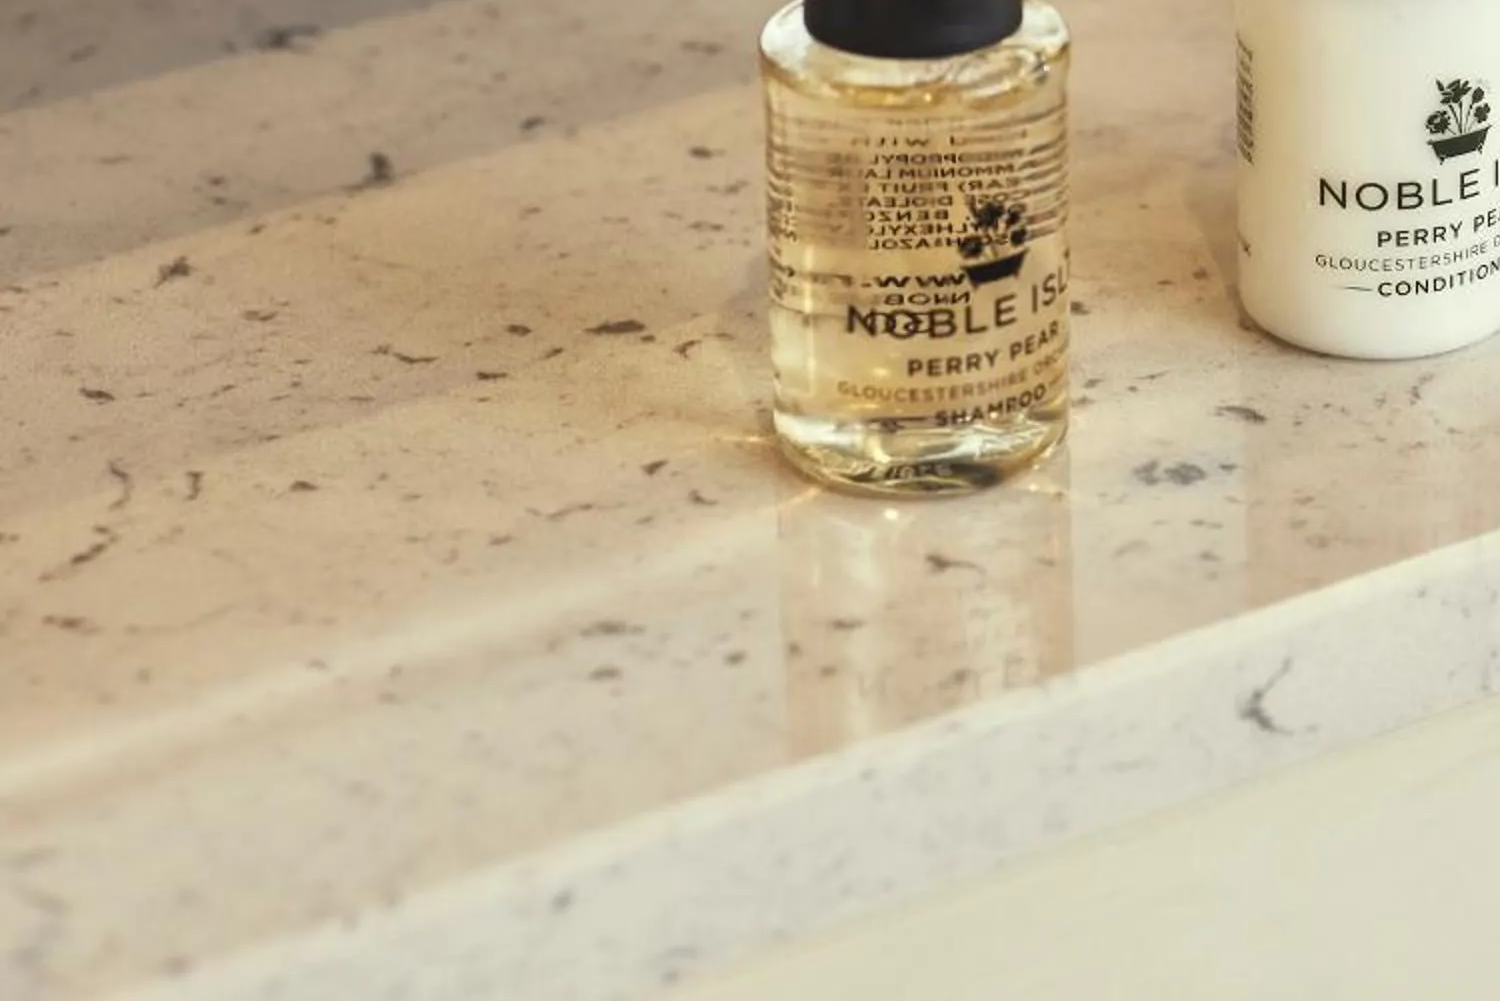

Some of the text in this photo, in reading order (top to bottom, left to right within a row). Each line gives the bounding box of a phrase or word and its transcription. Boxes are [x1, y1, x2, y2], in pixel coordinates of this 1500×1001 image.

[1319, 168, 1480, 212] NOBLE
[1377, 221, 1462, 248] PERRY
[1315, 241, 1487, 272] GLOUCESTERSHIRE
[847, 260, 1068, 338] NOBLE ISL
[907, 349, 1000, 377] PERRY
[1010, 320, 1058, 361] PEAR
[837, 367, 1027, 402] GLOUCESTERSHIRE
[934, 383, 1047, 426] SHAMPOO
